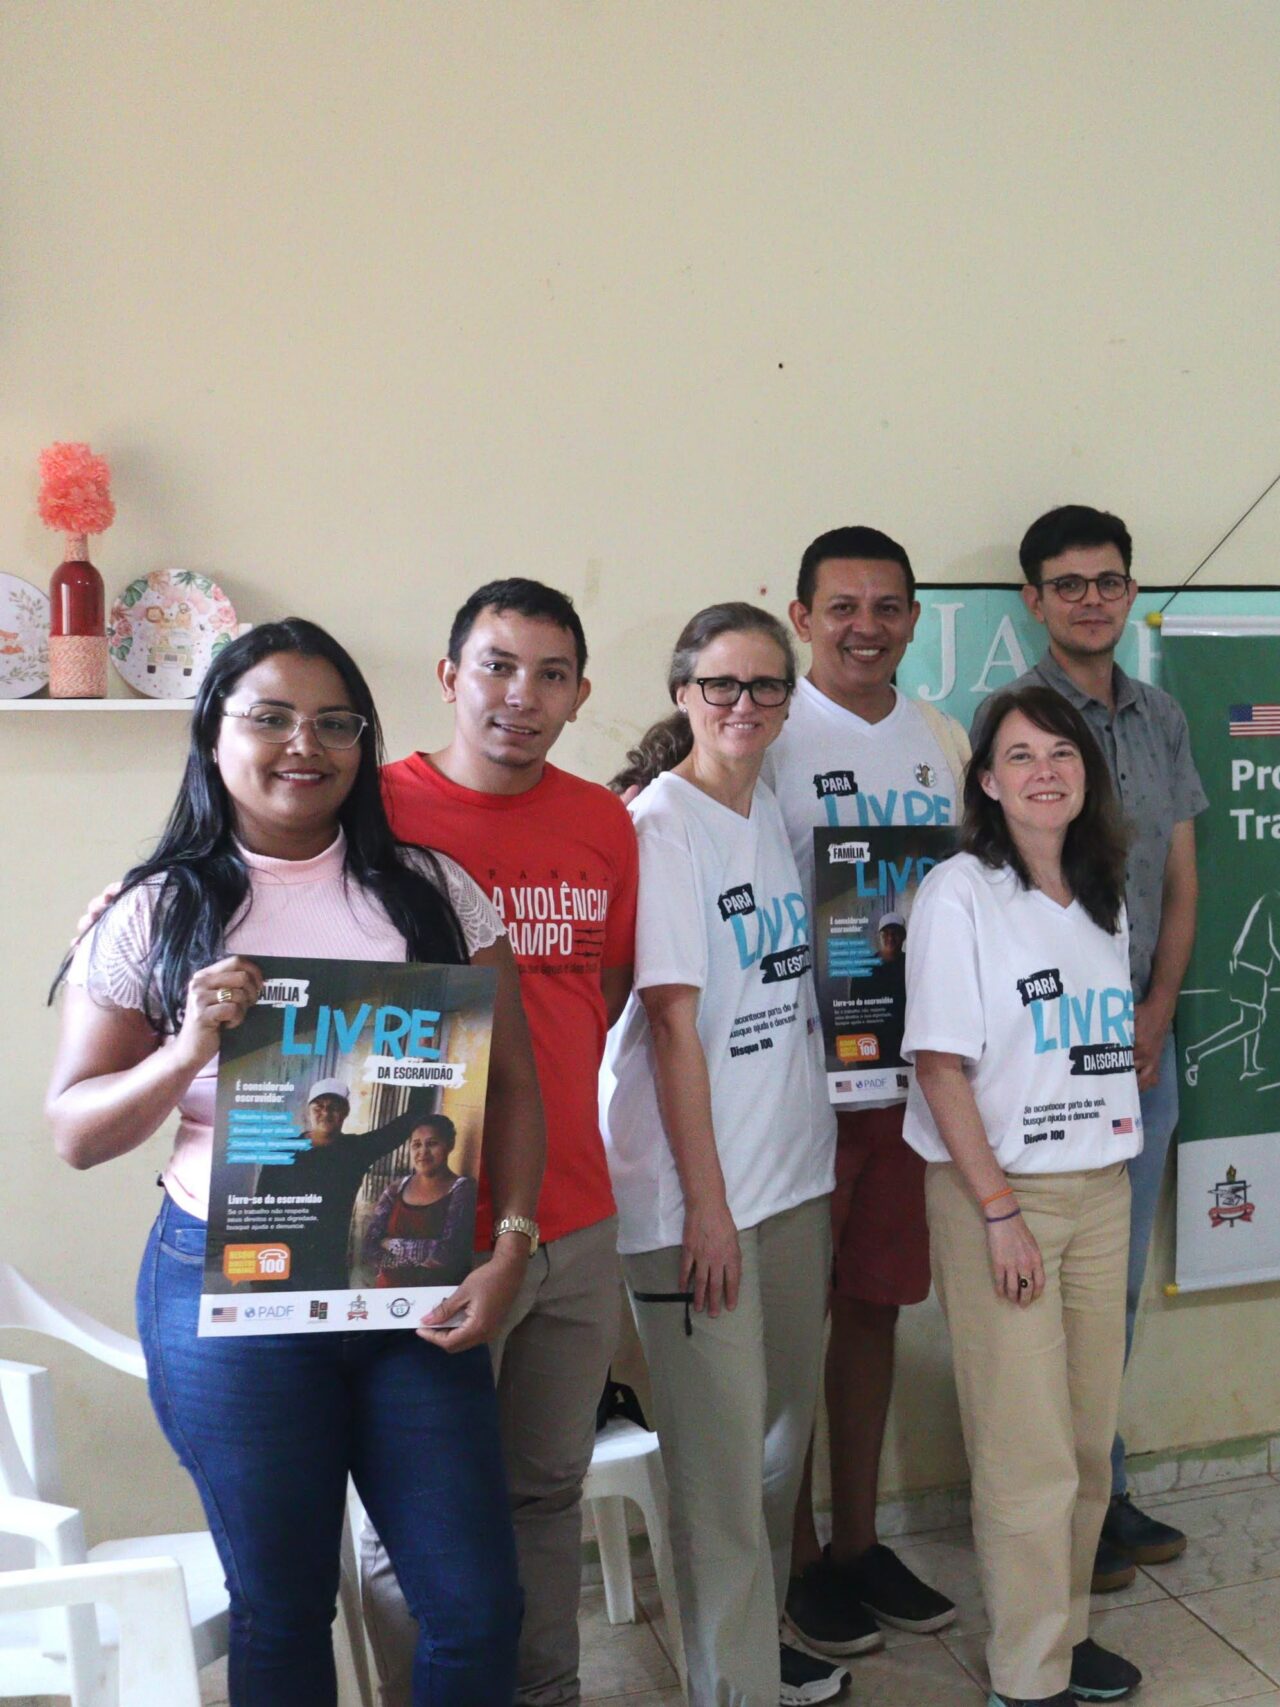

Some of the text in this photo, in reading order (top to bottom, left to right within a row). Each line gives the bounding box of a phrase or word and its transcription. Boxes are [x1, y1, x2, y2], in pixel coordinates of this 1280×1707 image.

[821, 774, 852, 793] PARÁ
[833, 845, 864, 859] FAMÍLIA
[510, 881, 608, 922] VIOLÊNCIA
[722, 888, 754, 914] PARÁ
[508, 922, 573, 956] AMPO
[731, 892, 808, 970] LIVR
[258, 982, 300, 1002] AMÍLIA
[1025, 973, 1058, 999] PARÁ
[281, 1002, 442, 1060] LIVRE
[730, 1037, 774, 1058] Disque 100
[1084, 1054, 1096, 1071] DA
[377, 1064, 453, 1081] DA ESCRAVIDÃO
[1050, 1129, 1065, 1141] 100
[228, 1194, 323, 1205] Livre-se da escravidão
[259, 1258, 286, 1274] 100
[258, 1305, 294, 1318] PADF
